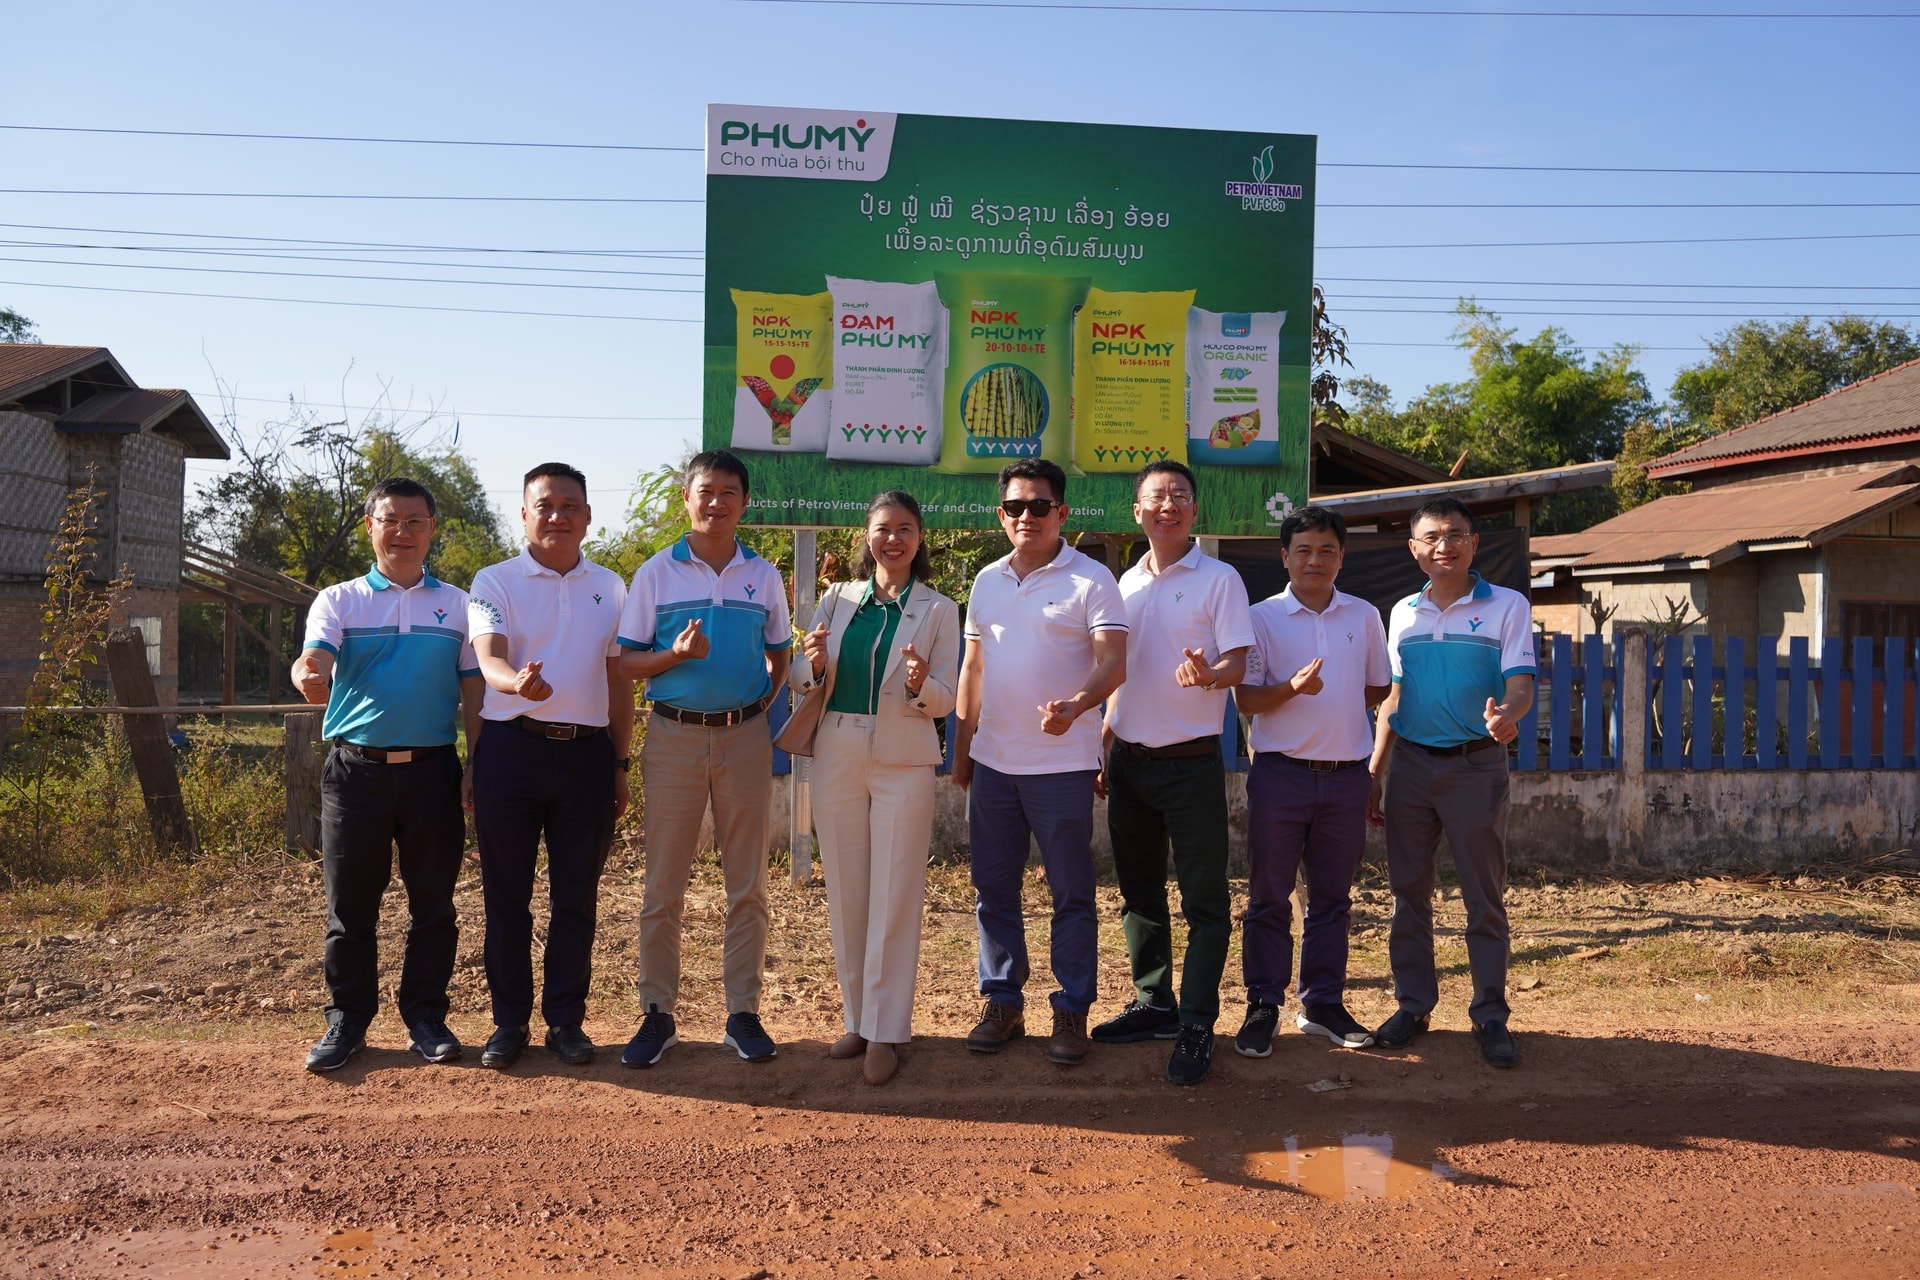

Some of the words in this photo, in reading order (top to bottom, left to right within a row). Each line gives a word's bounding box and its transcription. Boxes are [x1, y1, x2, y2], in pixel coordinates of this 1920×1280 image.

[721, 152, 755, 166] Cho
[762, 154, 798, 168] mùa
[805, 155, 831, 173] bội
[838, 158, 865, 172] thu
[1226, 182, 1302, 198] PETROVIETNAM
[1242, 196, 1285, 212] PVFCCo
[753, 315, 791, 327] NPK
[840, 314, 894, 330] ĐẠM
[971, 310, 1019, 325] NPK
[971, 326, 1014, 339] PHÚ
[1092, 322, 1146, 339] NPK
[841, 331, 893, 347] PHÚ
[985, 342, 1046, 354] 20-10-10+TE
[1092, 341, 1140, 355] PHÚ
[1203, 351, 1268, 362] ORGANIC
[746, 498, 778, 508] ducts
[782, 499, 795, 509] of
[799, 499, 870, 511] PetroVietna
[943, 503, 965, 513] and
[1070, 506, 1105, 516] ration
